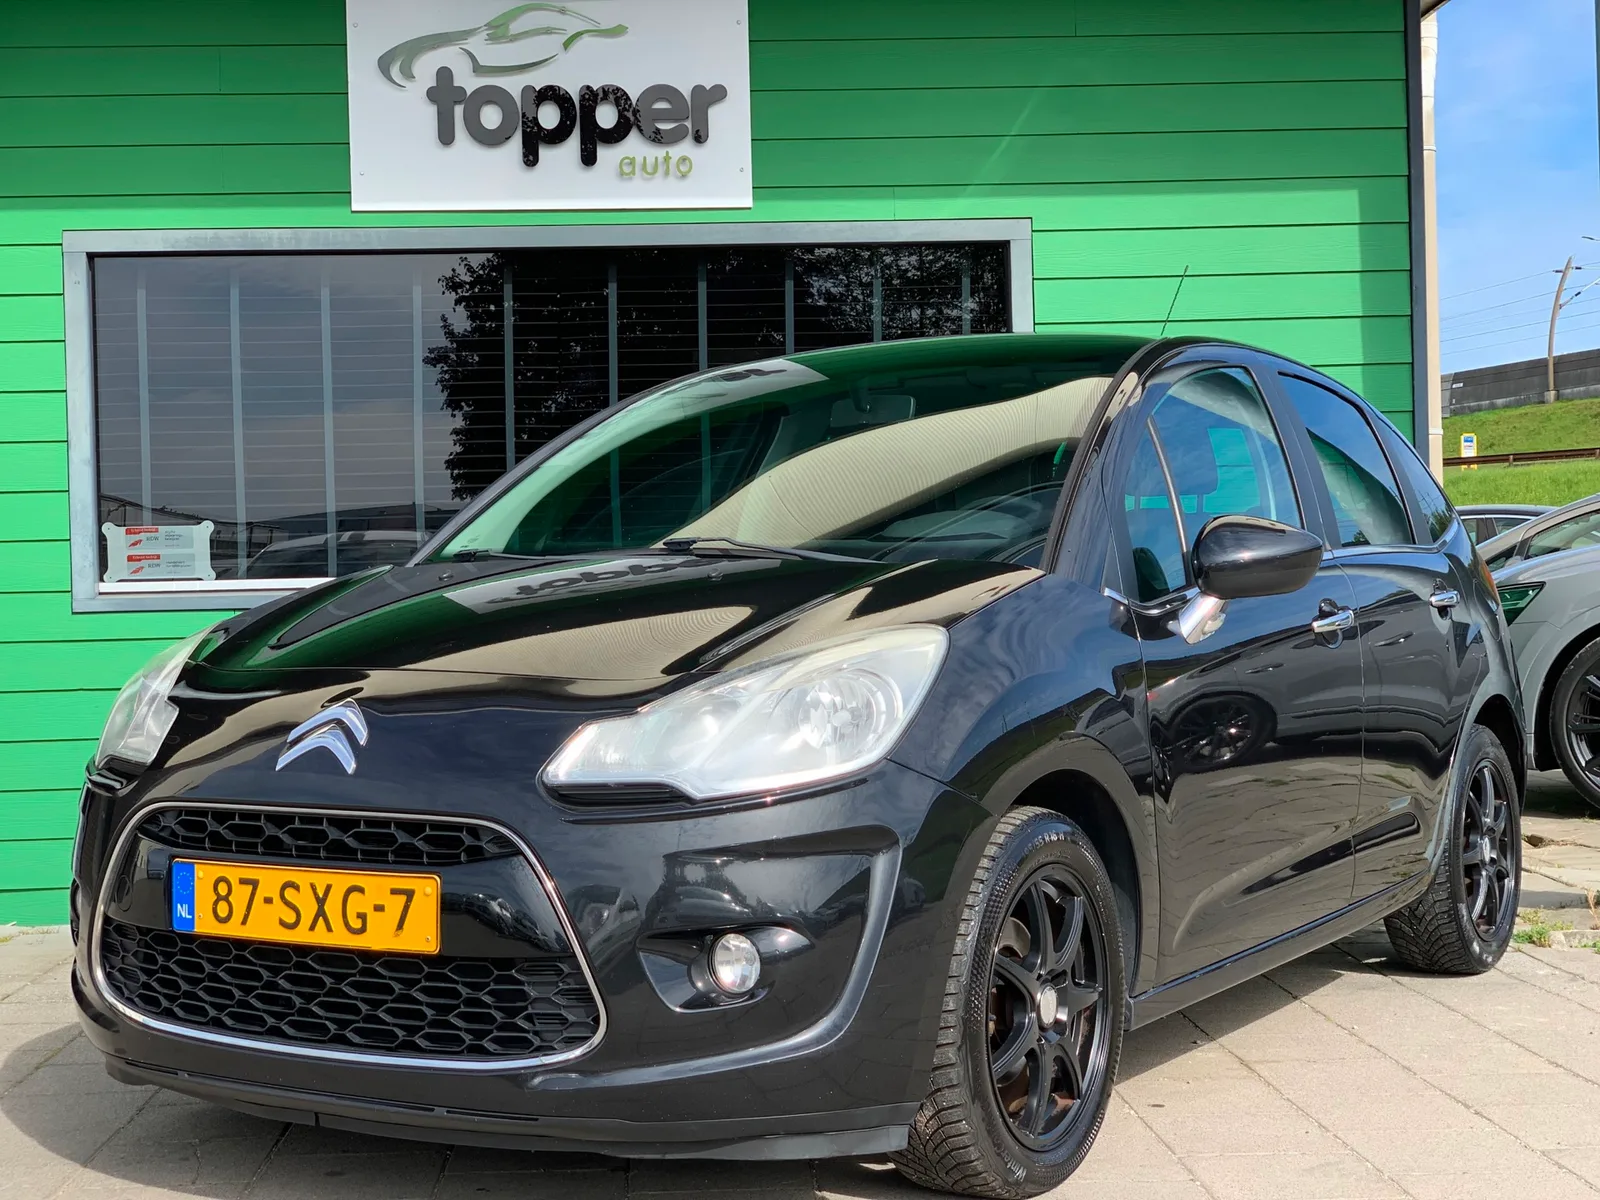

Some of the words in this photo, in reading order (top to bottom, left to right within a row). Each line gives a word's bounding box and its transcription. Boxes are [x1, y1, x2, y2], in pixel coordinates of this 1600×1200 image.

[426, 65, 728, 168] topper
[618, 150, 694, 178] auto
[177, 903, 193, 919] NL
[211, 875, 417, 938] 87-SXG-7
